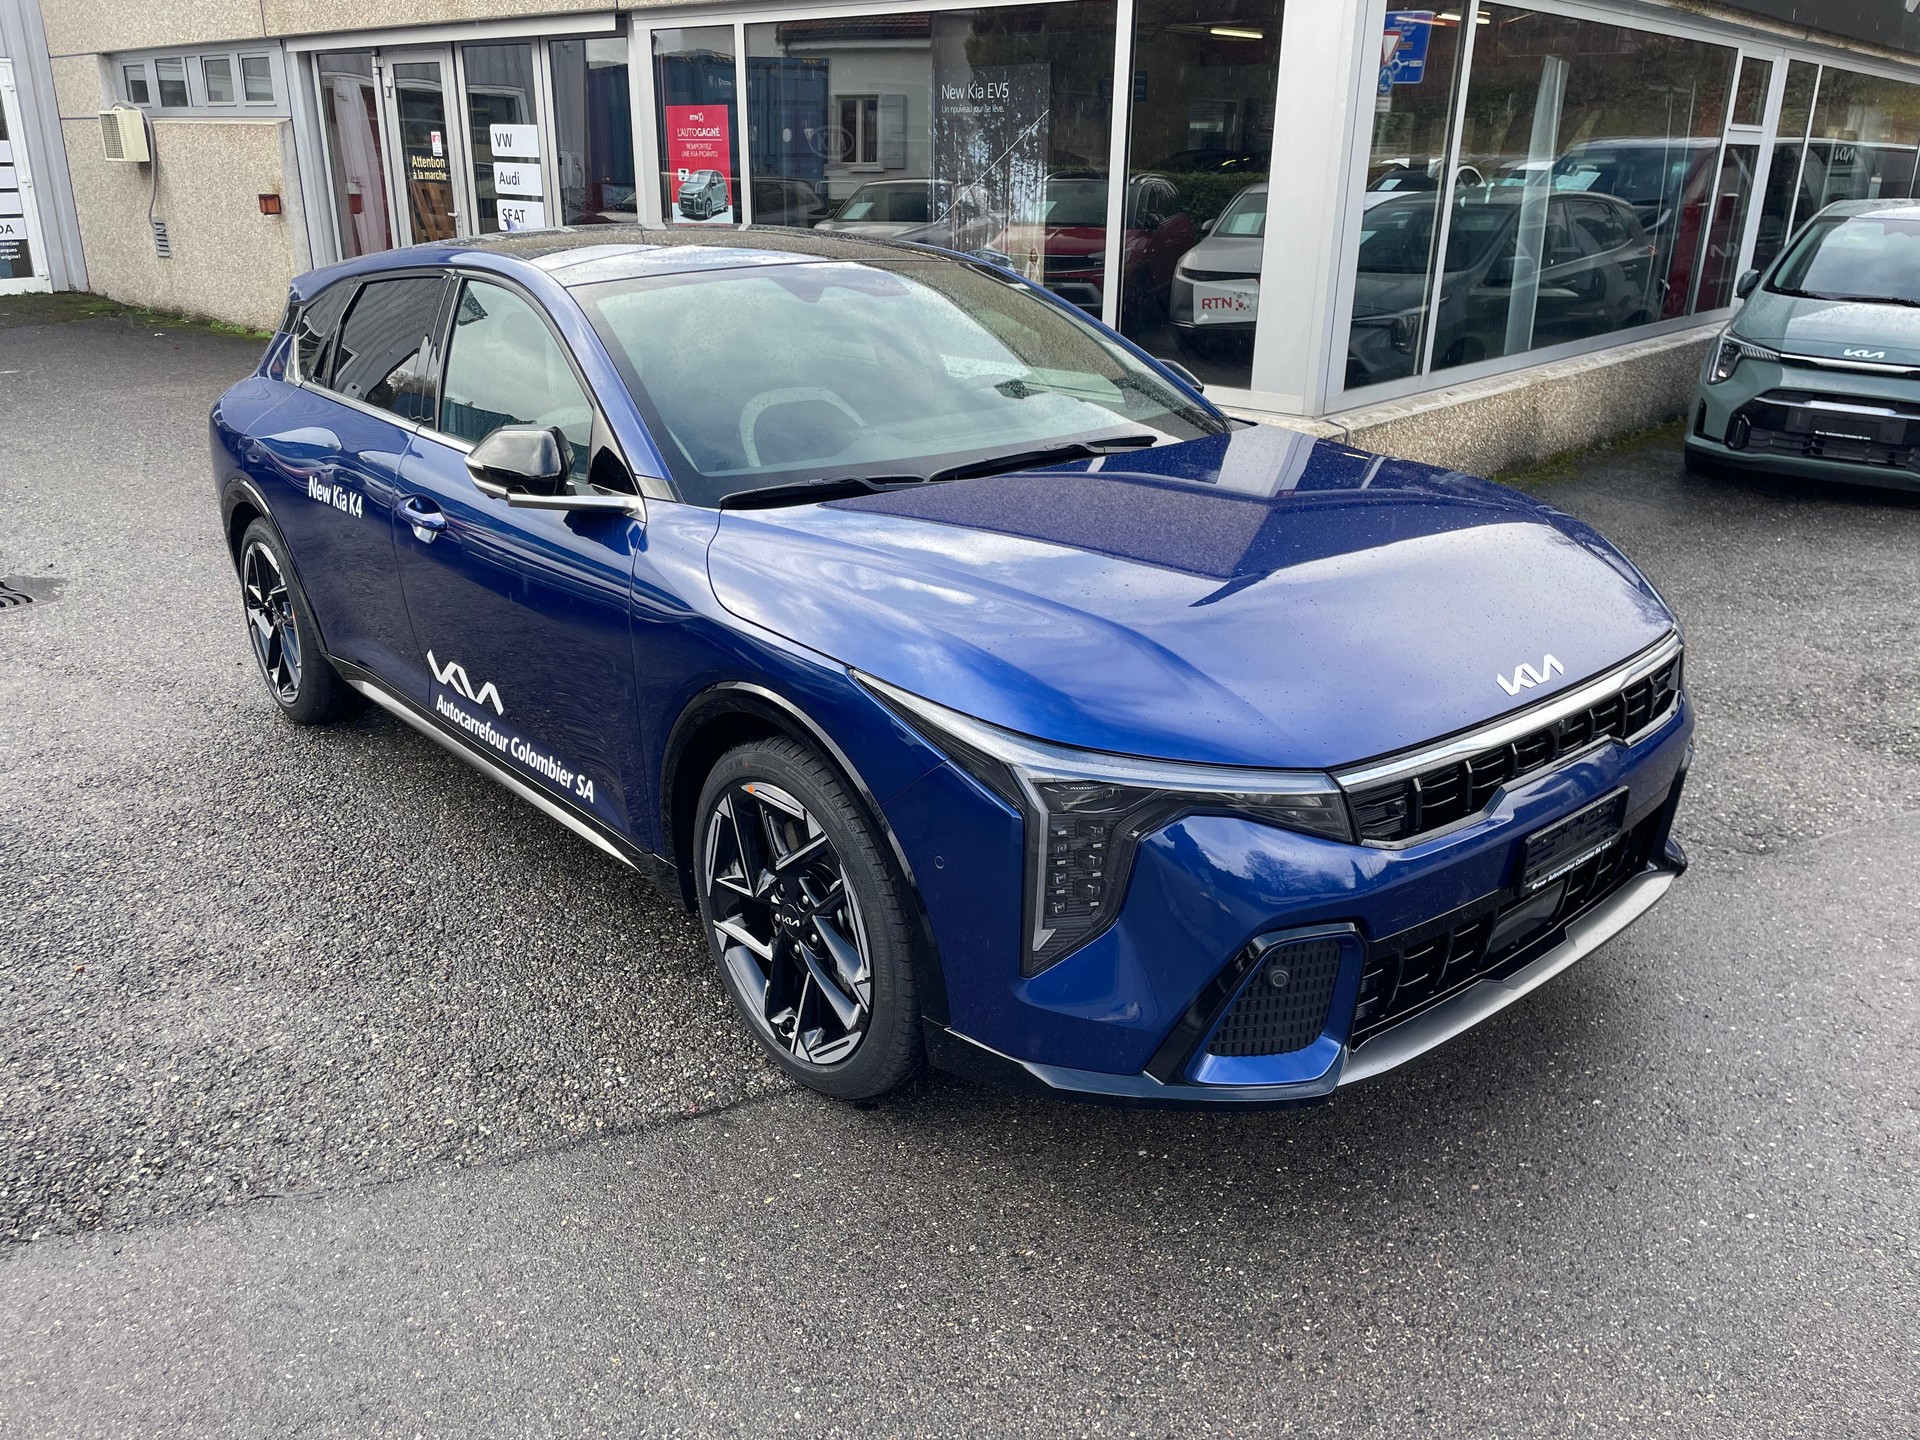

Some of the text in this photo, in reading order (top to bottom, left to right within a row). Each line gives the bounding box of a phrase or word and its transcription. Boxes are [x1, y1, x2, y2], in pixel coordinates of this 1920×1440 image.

[942, 82, 1009, 99] New Kia EV5
[942, 105, 950, 113] Un
[950, 105, 972, 114] nouveau
[972, 104, 984, 115] jour
[495, 133, 513, 148] VW
[412, 155, 446, 168] Attention
[682, 150, 719, 158] UNE KIA PICANTO
[413, 169, 447, 180] à la marche
[499, 171, 520, 186] Audi
[502, 208, 526, 224] SEAT
[1201, 297, 1233, 310] RTN
[1843, 348, 1886, 359] KIA
[308, 475, 363, 519] New Kia K4
[427, 649, 504, 716] KIA
[1497, 653, 1564, 697] KIA
[436, 694, 595, 804] Autocarrefour Colombier SA
[781, 914, 801, 928] KIA
